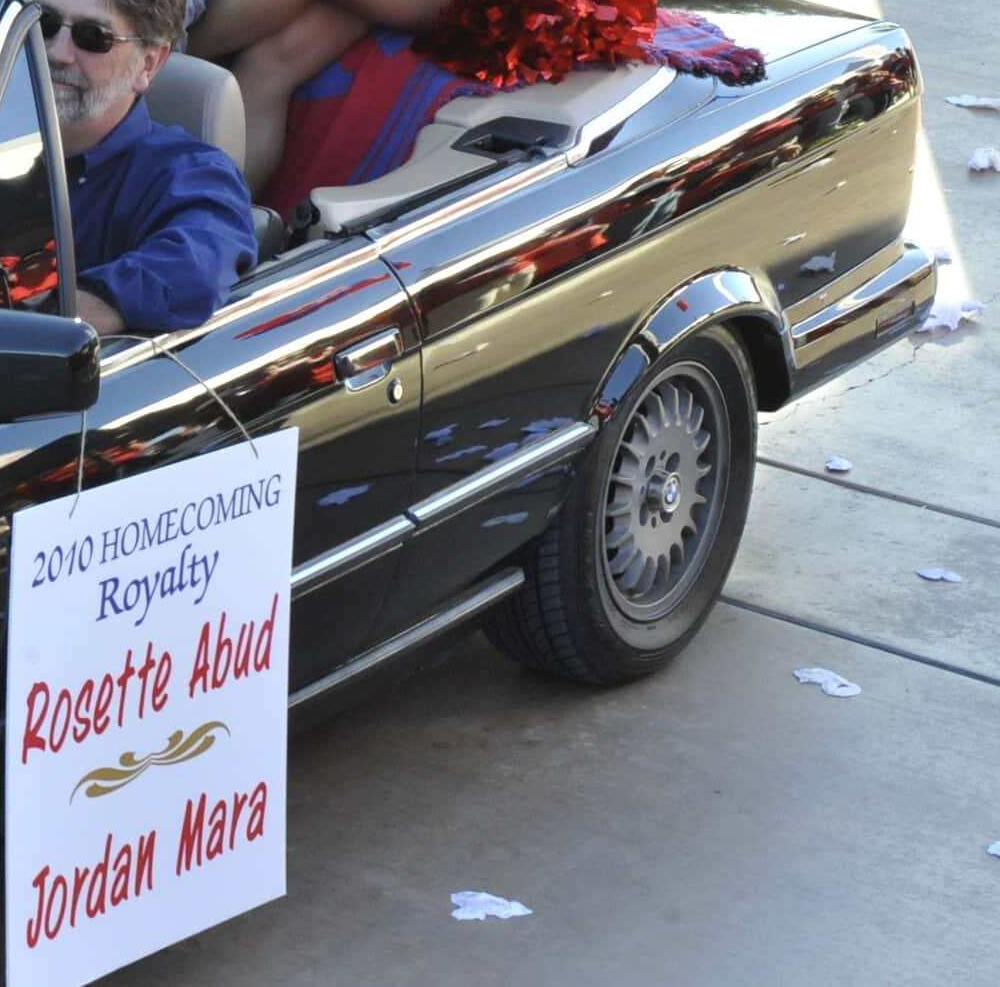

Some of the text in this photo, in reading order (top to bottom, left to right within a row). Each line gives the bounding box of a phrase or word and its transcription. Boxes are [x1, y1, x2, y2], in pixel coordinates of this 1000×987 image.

[32, 473, 281, 588] 2010 HOMECOMING
[96, 542, 219, 626] Royalty
[21, 592, 279, 764] Rosette Abud
[26, 781, 267, 949] Jordan Mara
